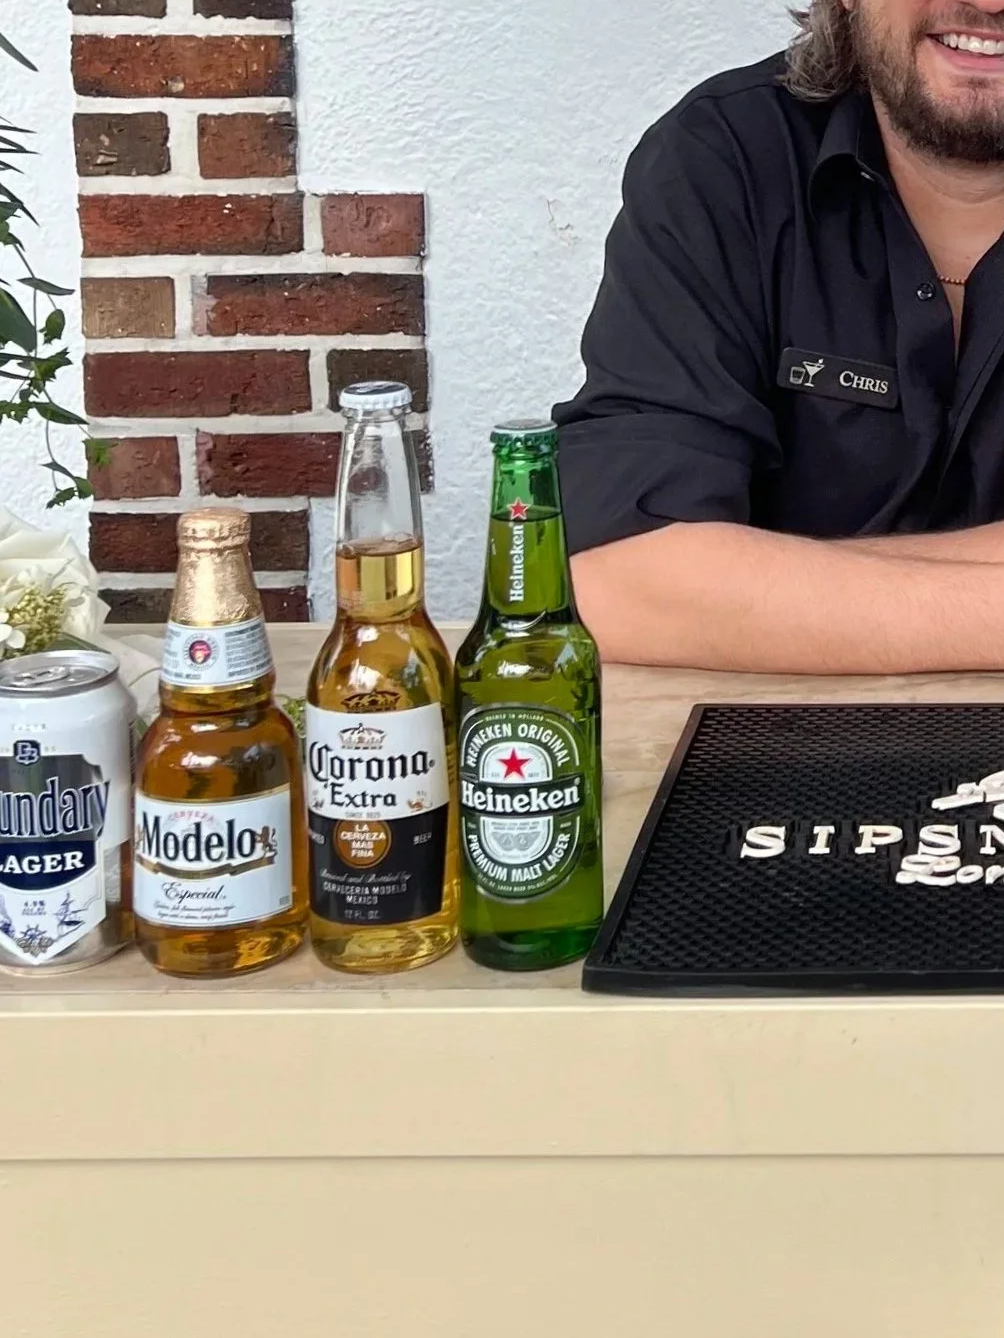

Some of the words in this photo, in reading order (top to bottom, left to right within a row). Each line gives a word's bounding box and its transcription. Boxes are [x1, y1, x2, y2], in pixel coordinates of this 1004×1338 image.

[509, 524, 524, 602] Heineken
[464, 723, 512, 768] HEINEKEN
[517, 723, 570, 768] ORIGINAL
[308, 741, 429, 789] Corona
[330, 783, 397, 808] Extra
[461, 780, 580, 813] Heineken
[141, 811, 257, 863] Modelo
[340, 831, 387, 841] CERVEZA
[355, 823, 370, 832] LA
[0, 850, 85, 874] AGER
[352, 849, 374, 858] FINA
[468, 833, 508, 882] PREMIUM
[511, 862, 542, 883] MALT
[542, 833, 571, 872] LAGER
[161, 881, 225, 904] Especial
[345, 894, 379, 905] MEXICO
[371, 883, 408, 895] MODELO
